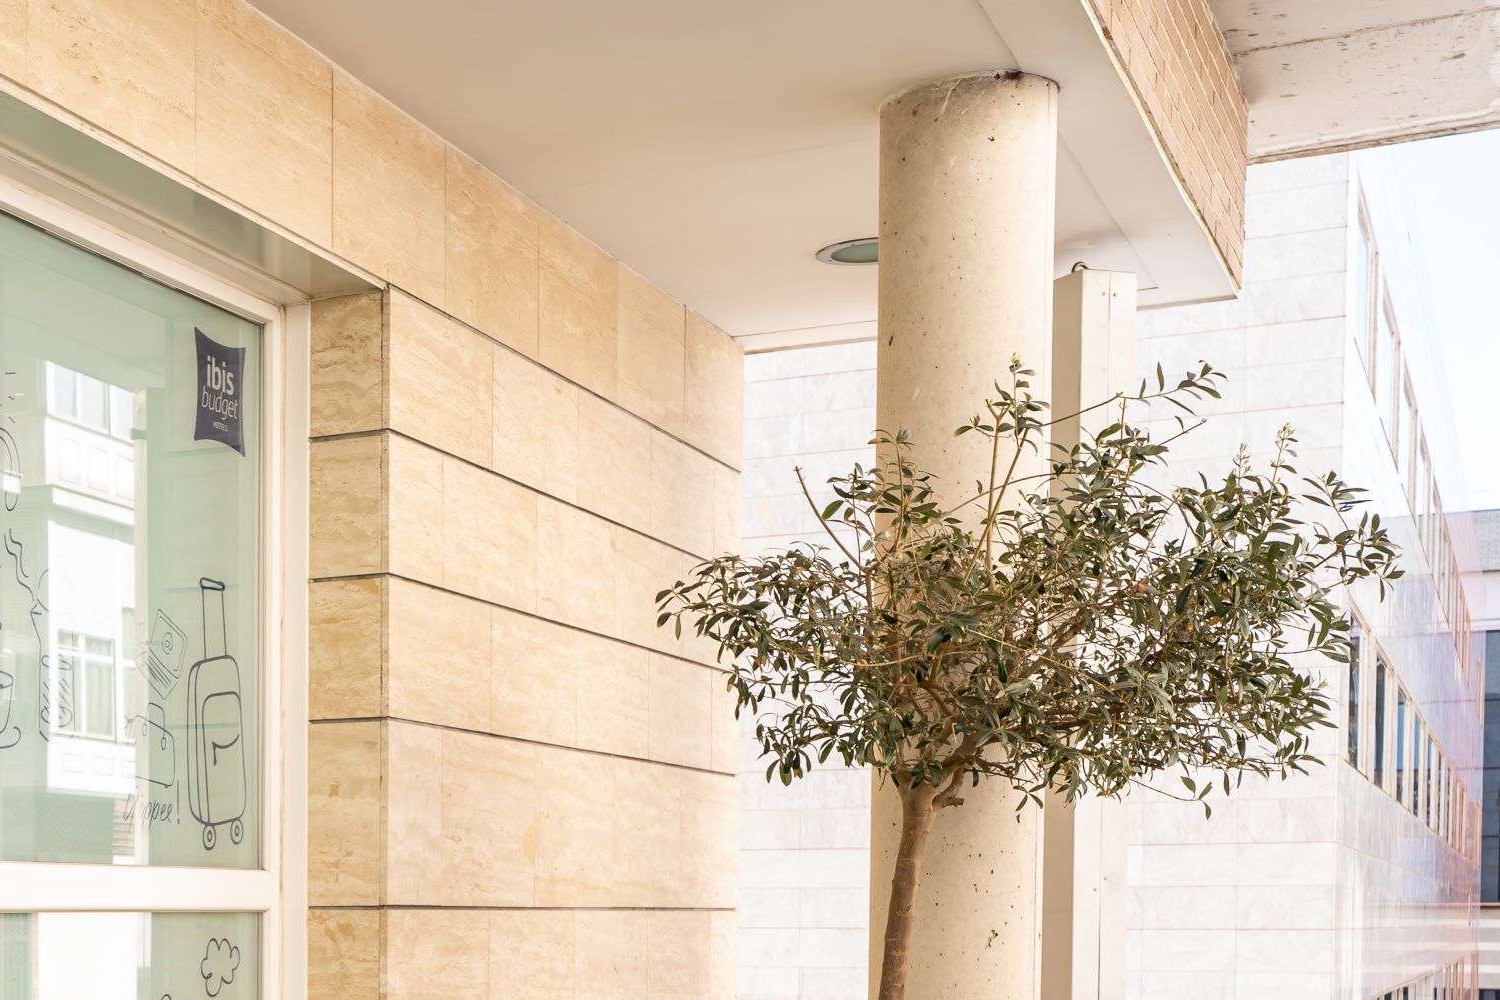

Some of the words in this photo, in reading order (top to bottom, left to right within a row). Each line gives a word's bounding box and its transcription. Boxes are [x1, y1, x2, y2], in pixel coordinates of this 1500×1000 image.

[206, 355, 235, 396] ibis
[201, 385, 239, 420] budget
[212, 420, 229, 432] HOTELS
